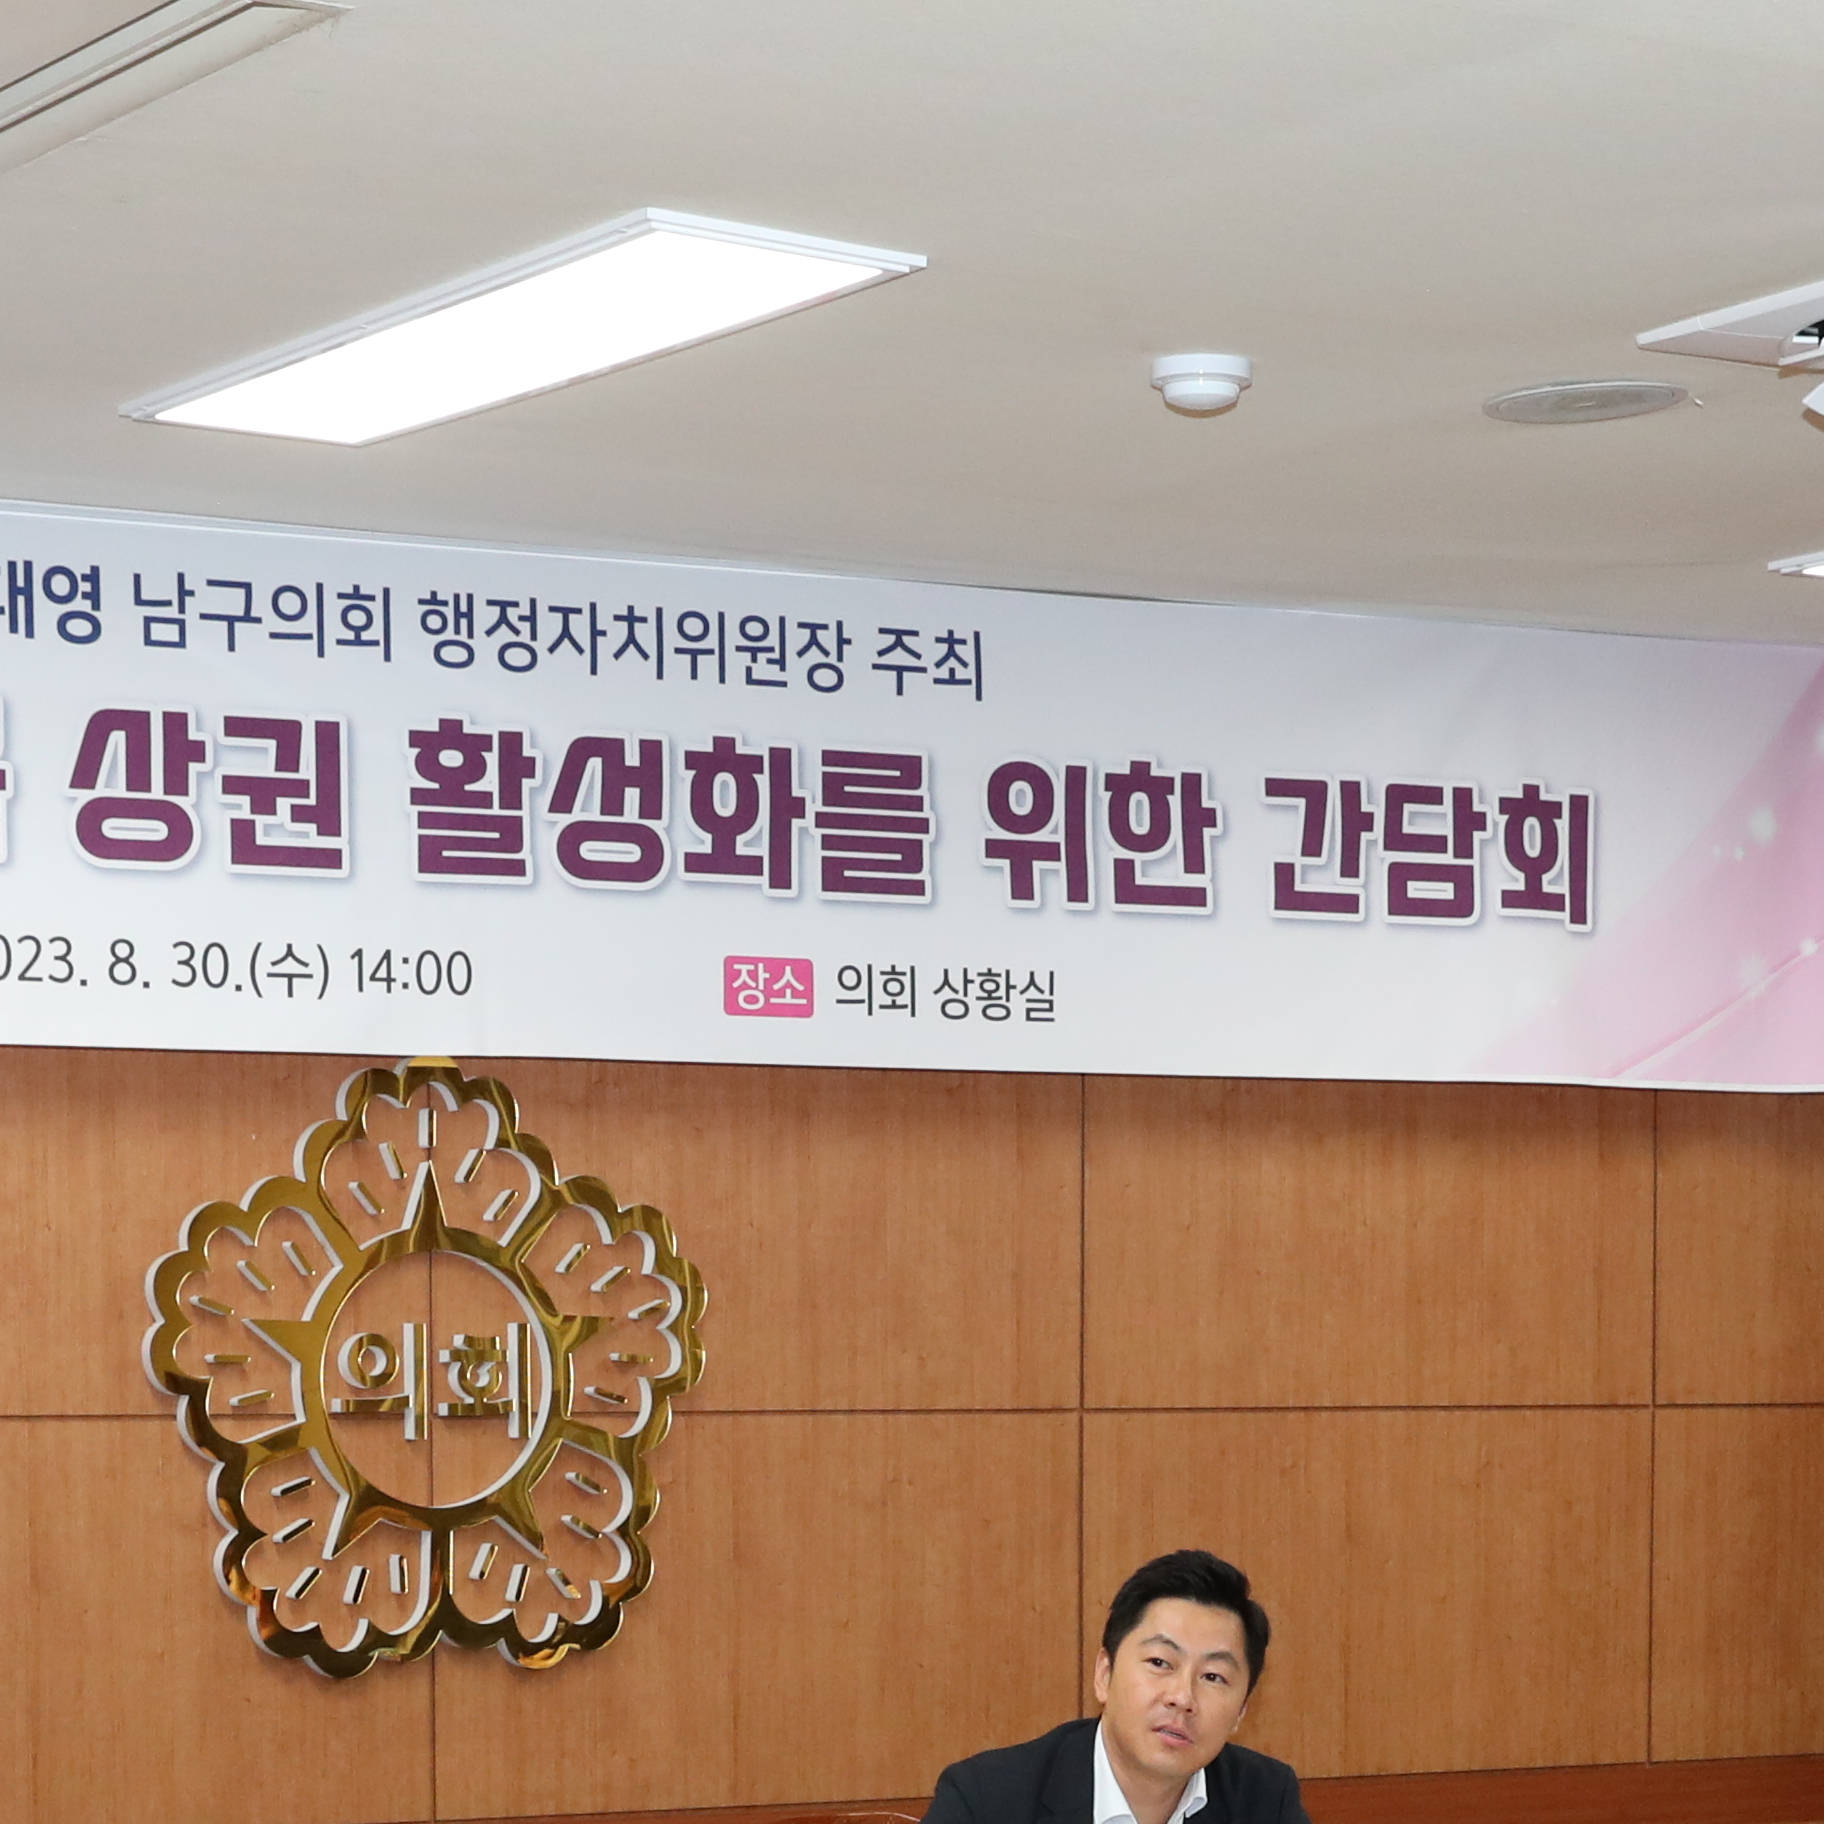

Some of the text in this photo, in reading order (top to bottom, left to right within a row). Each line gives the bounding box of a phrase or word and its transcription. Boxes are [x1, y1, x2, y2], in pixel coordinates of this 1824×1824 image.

[131, 577, 394, 663] 남구의회
[416, 589, 854, 695] 행정자치위원장
[870, 626, 984, 703] 주최
[66, 706, 345, 872] 상권
[406, 716, 932, 898] 활성화를
[982, 758, 1220, 909] 위한
[1263, 776, 1591, 927] 간담회
[107, 937, 151, 989] 8.
[170, 940, 330, 1001] 30.(수)
[349, 947, 473, 997] 14:00
[731, 962, 1056, 1023] 장소 의회 상황실
[331, 1321, 531, 1440] 의회
